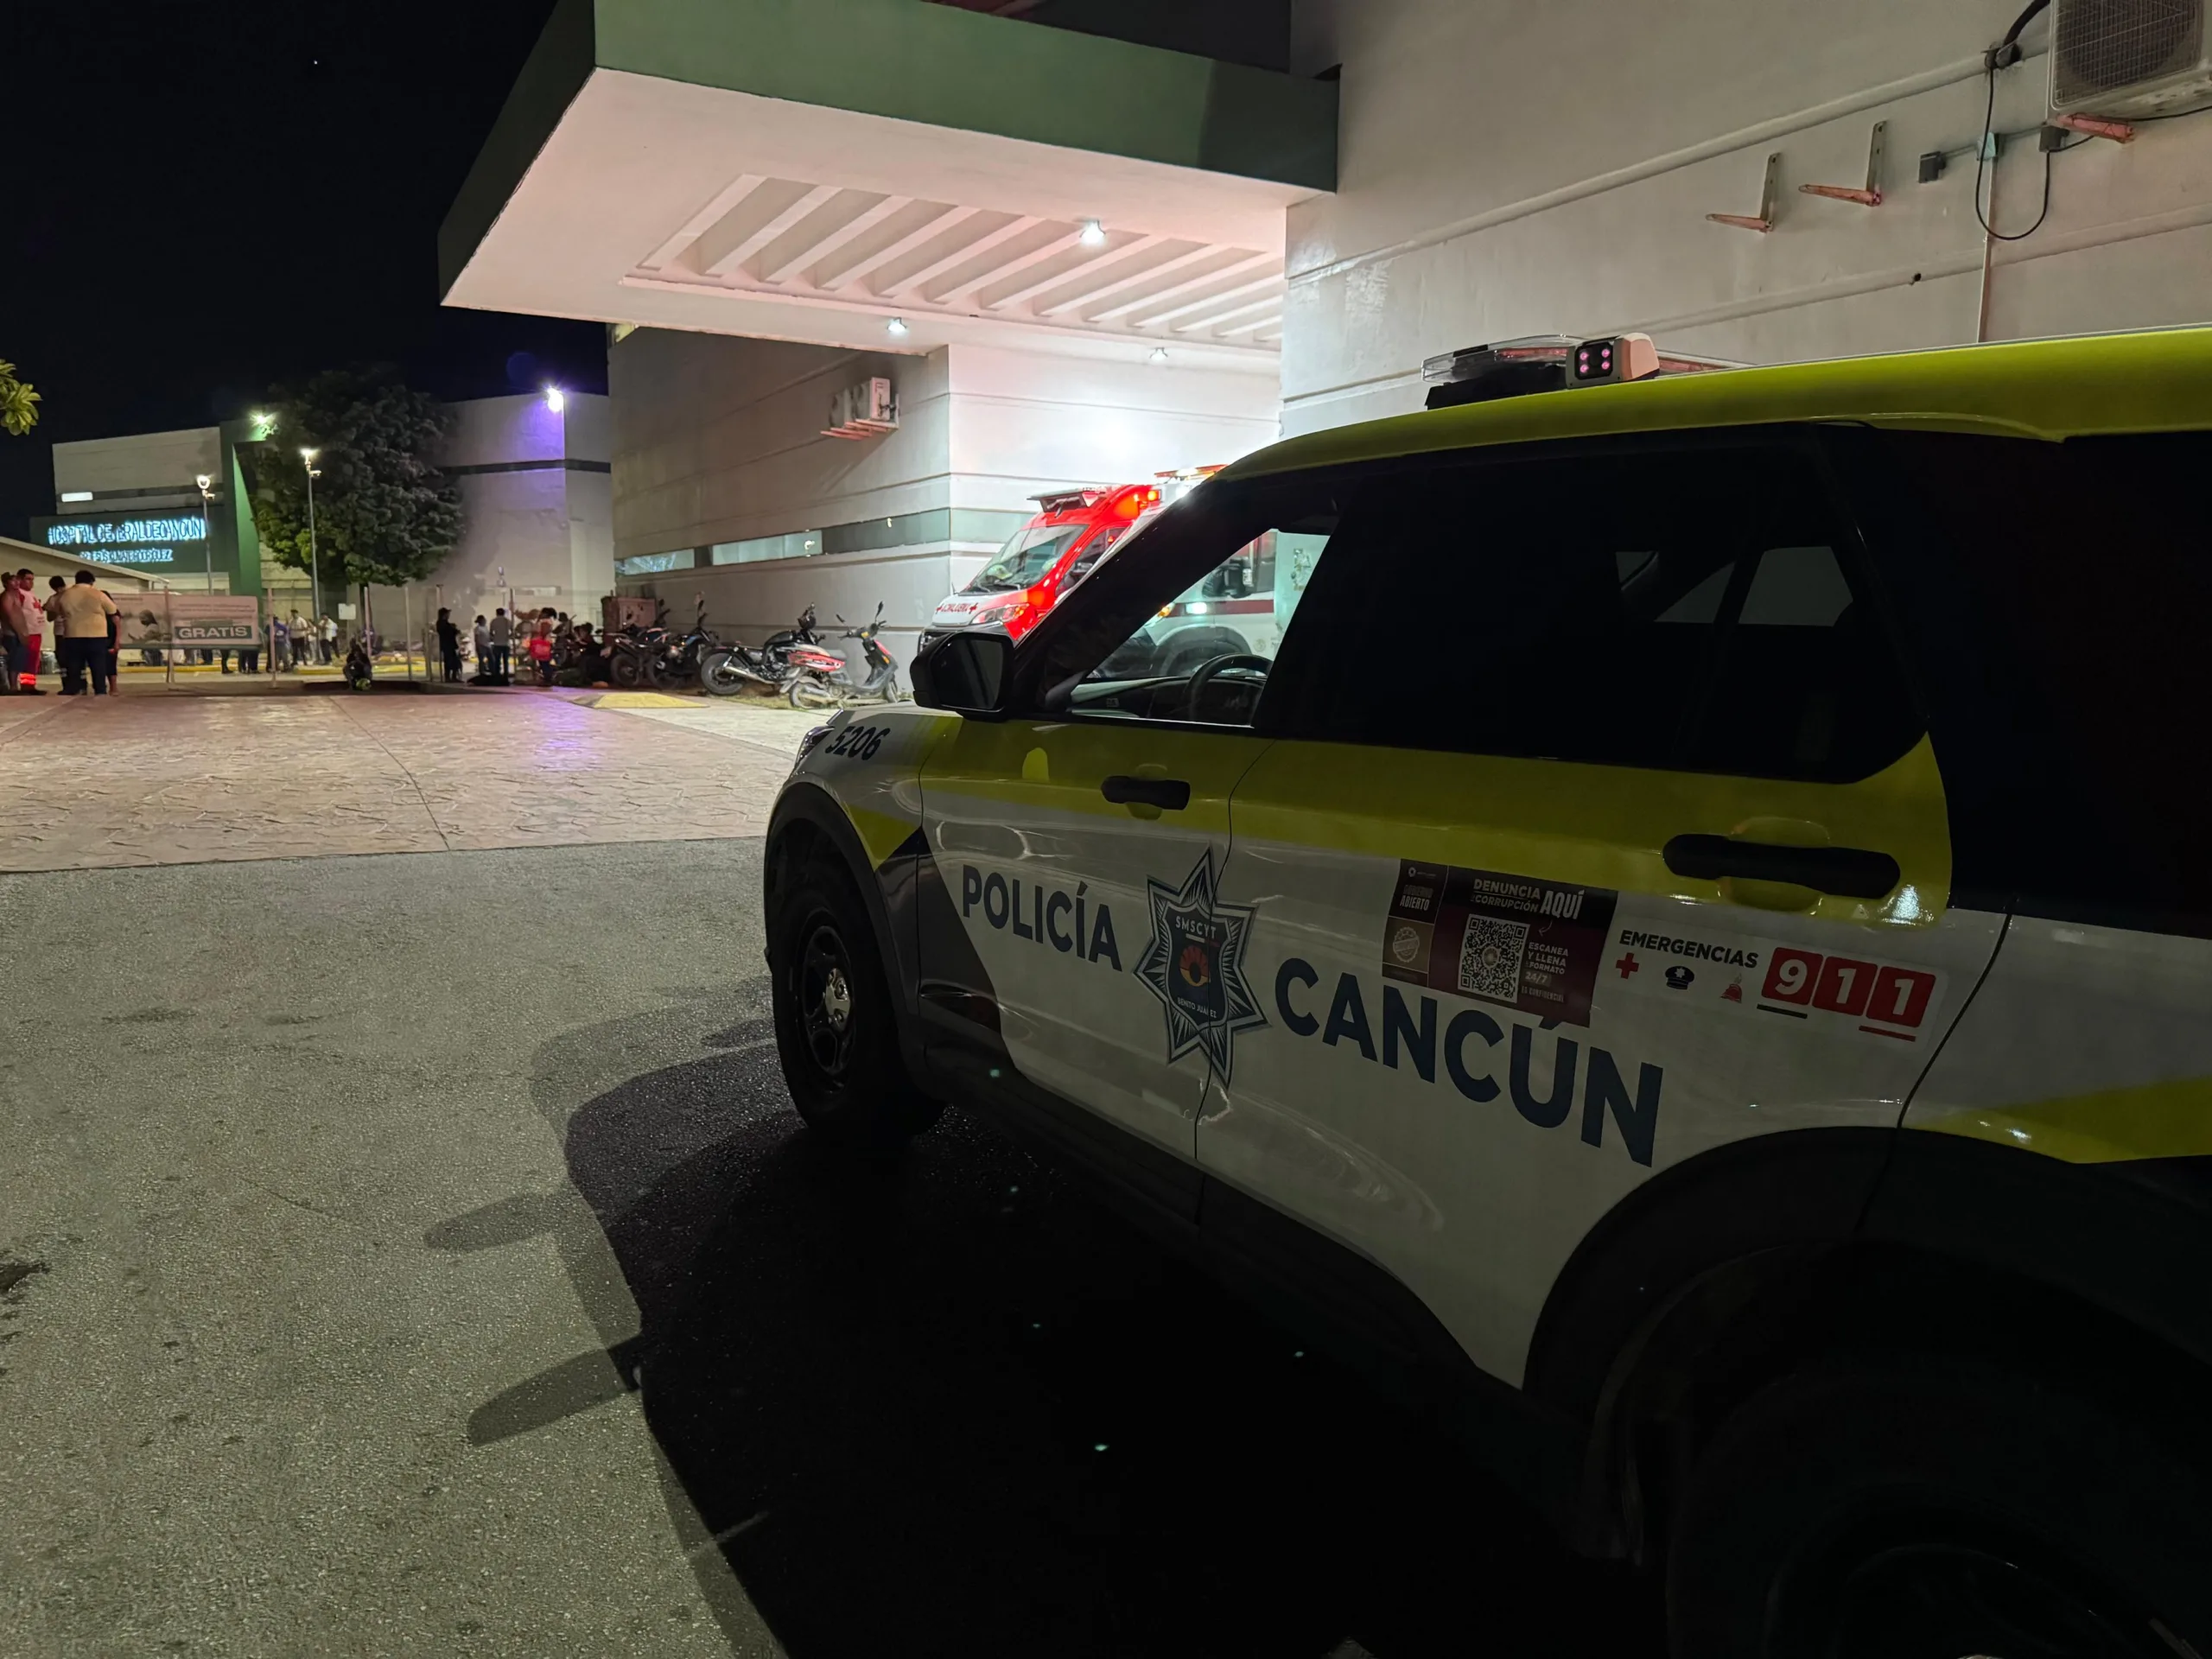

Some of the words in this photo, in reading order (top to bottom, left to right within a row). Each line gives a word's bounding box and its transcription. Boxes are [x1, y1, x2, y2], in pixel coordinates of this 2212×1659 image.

[178, 626, 248, 639] GRATIS
[825, 726, 891, 760] 5206
[1473, 878, 1541, 899] DENUNCIA
[1399, 894, 1430, 911] ABIERTO
[1475, 893, 1540, 913] CORRUPCIÓN
[1540, 888, 1586, 920] AQUÍ
[963, 864, 1122, 972] POLICÍA
[1175, 915, 1217, 940] SMSCYT
[1528, 950, 1534, 960] Y
[1535, 953, 1566, 967] LLENA
[1529, 942, 1569, 957] ESCANEA
[1619, 929, 1759, 969] EMERGENCIAS
[1524, 971, 1548, 984] 24/7
[1529, 962, 1565, 975] FORMATO
[1775, 958, 1915, 1016] 911
[1177, 997, 1196, 1011] BENITO
[1274, 957, 1663, 1168] CANCÚN
